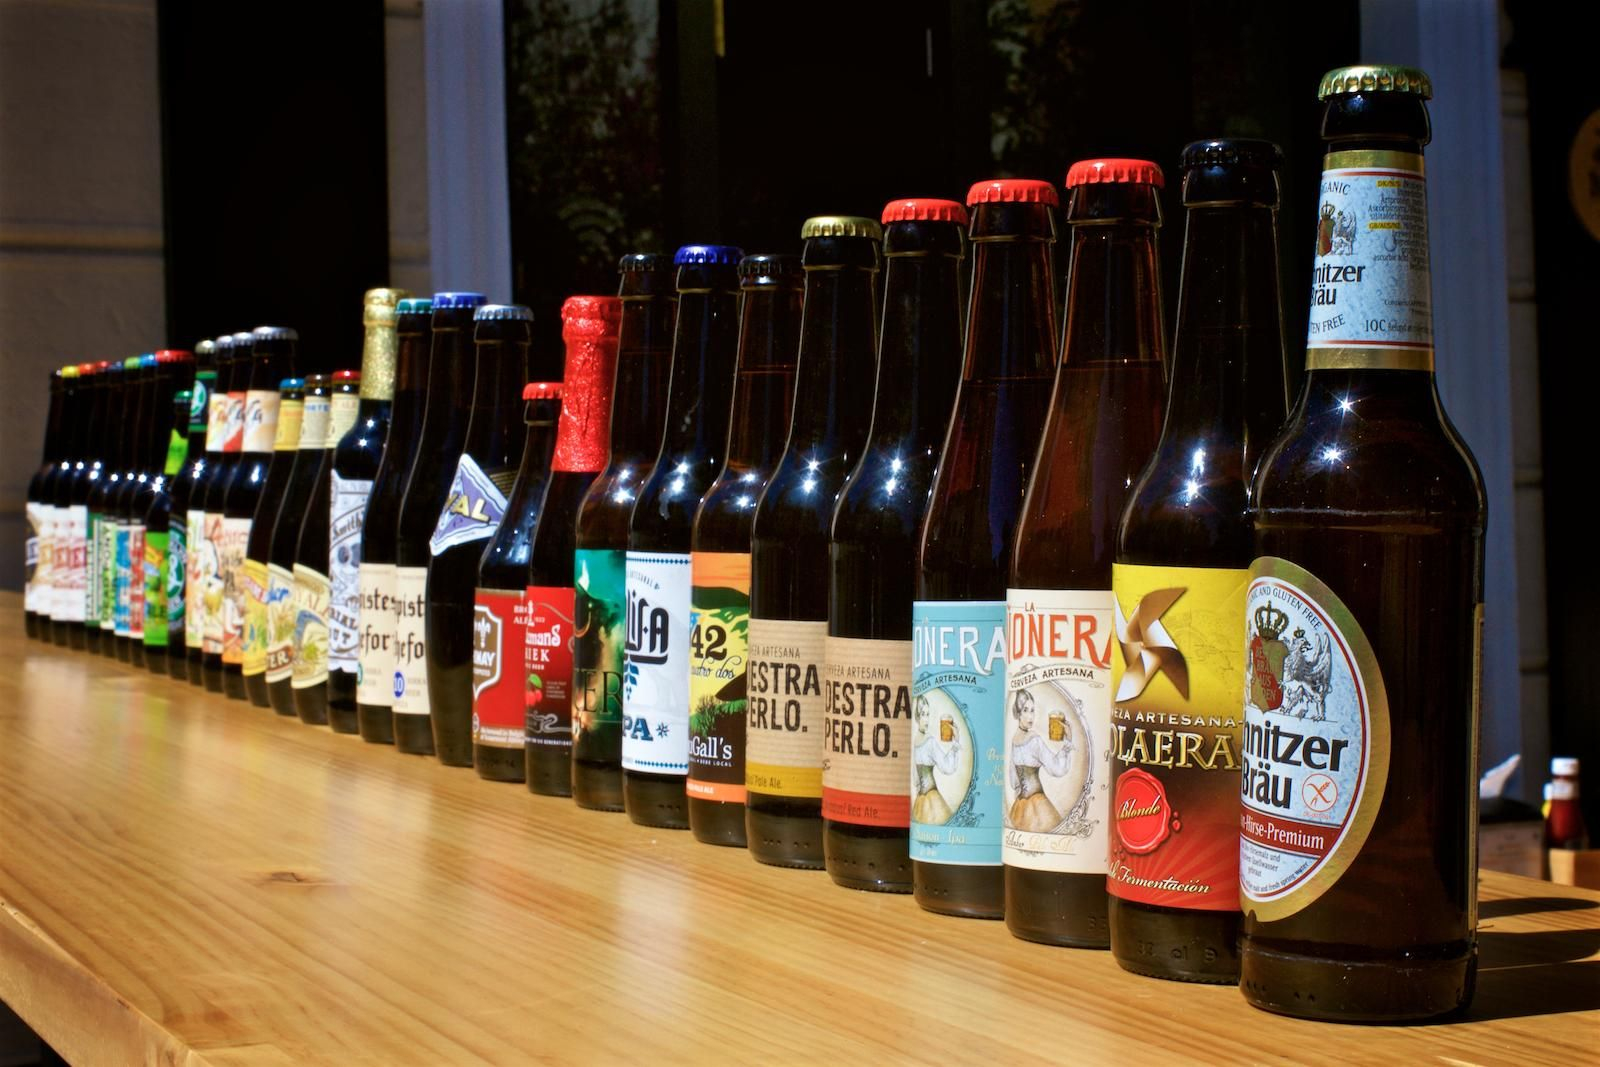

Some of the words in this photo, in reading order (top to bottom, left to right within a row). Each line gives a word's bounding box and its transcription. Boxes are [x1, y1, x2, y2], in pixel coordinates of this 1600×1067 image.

[1323, 314, 1346, 333] FREE
[1024, 601, 1036, 612] LA
[1260, 586, 1271, 597] AND
[1272, 588, 1304, 611] GLUTEN
[1302, 606, 1323, 631] FREE
[691, 624, 728, 661] 42
[761, 646, 801, 659] ARTESANA
[846, 666, 891, 681] ARTESANA
[934, 674, 977, 686] ARTESANA
[1010, 673, 1038, 688] CERVEZA
[1042, 667, 1095, 680] ARTESANA
[825, 679, 912, 720] DESTRA
[824, 717, 899, 759] PERLO.
[1242, 756, 1293, 810] Bräu
[1119, 794, 1161, 819] Blonde
[1117, 865, 1211, 894] Fermentación
